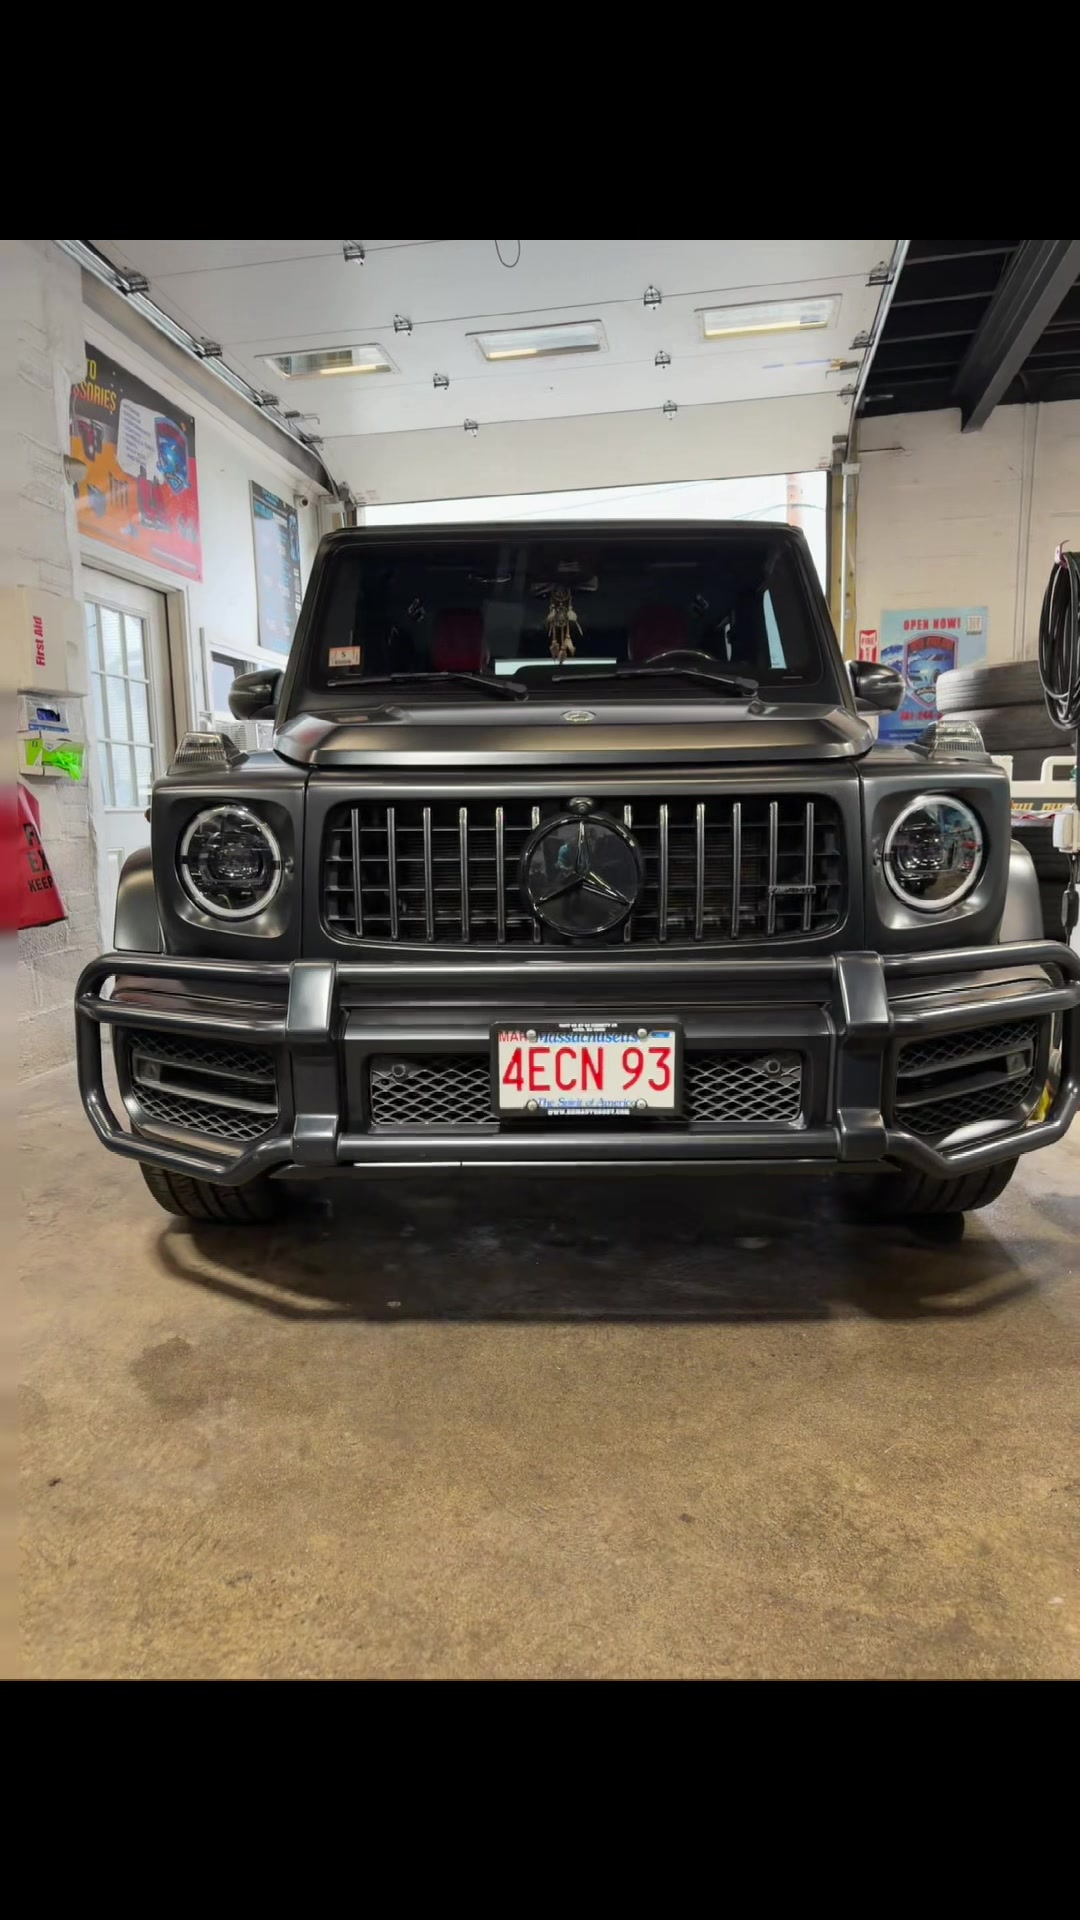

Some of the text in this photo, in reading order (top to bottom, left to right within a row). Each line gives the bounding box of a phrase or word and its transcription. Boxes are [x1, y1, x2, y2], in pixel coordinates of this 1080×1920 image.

[903, 619, 929, 631] OPEN
[933, 617, 961, 629] NOW!
[33, 615, 46, 667] First Aid
[28, 875, 54, 892] KEEP
[502, 1047, 671, 1091] 4ECN 93
[537, 1097, 554, 1108] The
